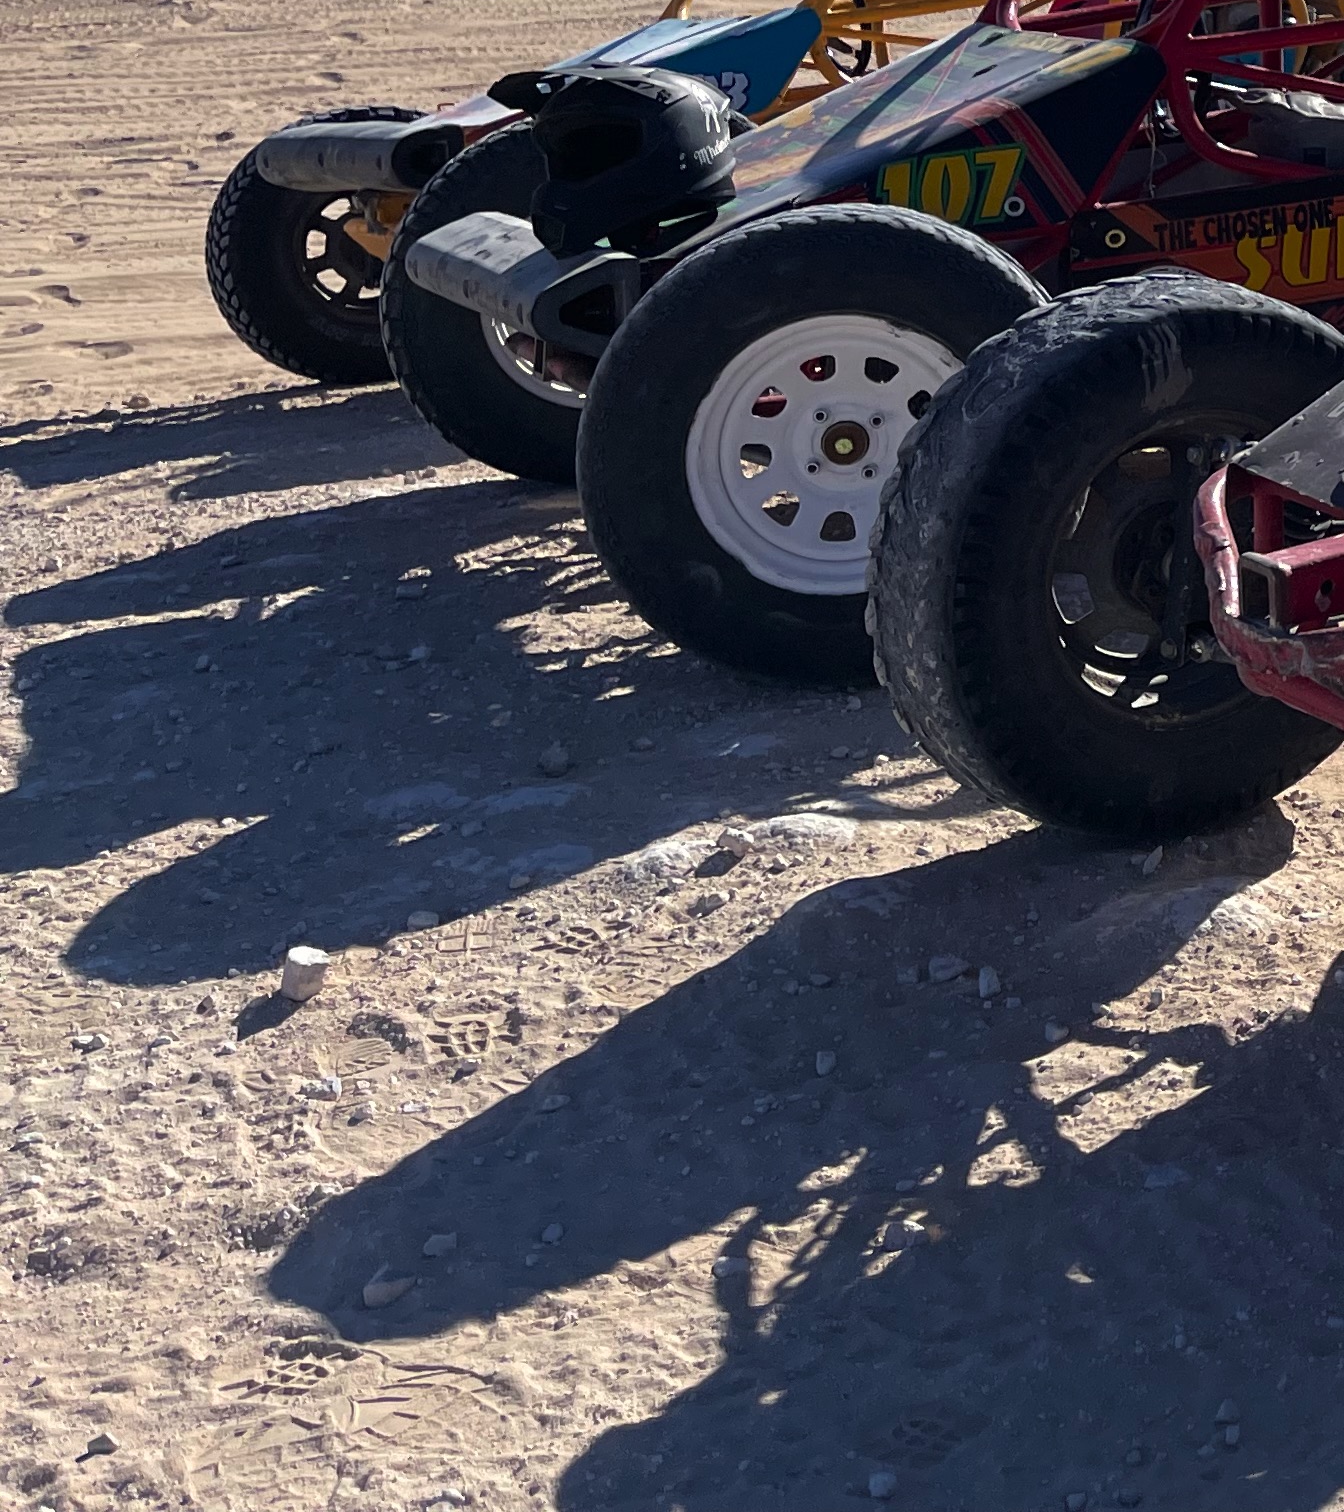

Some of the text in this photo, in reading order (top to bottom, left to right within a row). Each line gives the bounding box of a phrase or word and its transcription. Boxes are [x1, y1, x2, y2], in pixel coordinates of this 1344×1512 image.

[876, 143, 1028, 226] 107
[1153, 198, 1336, 252] THE CHOSEN ONE
